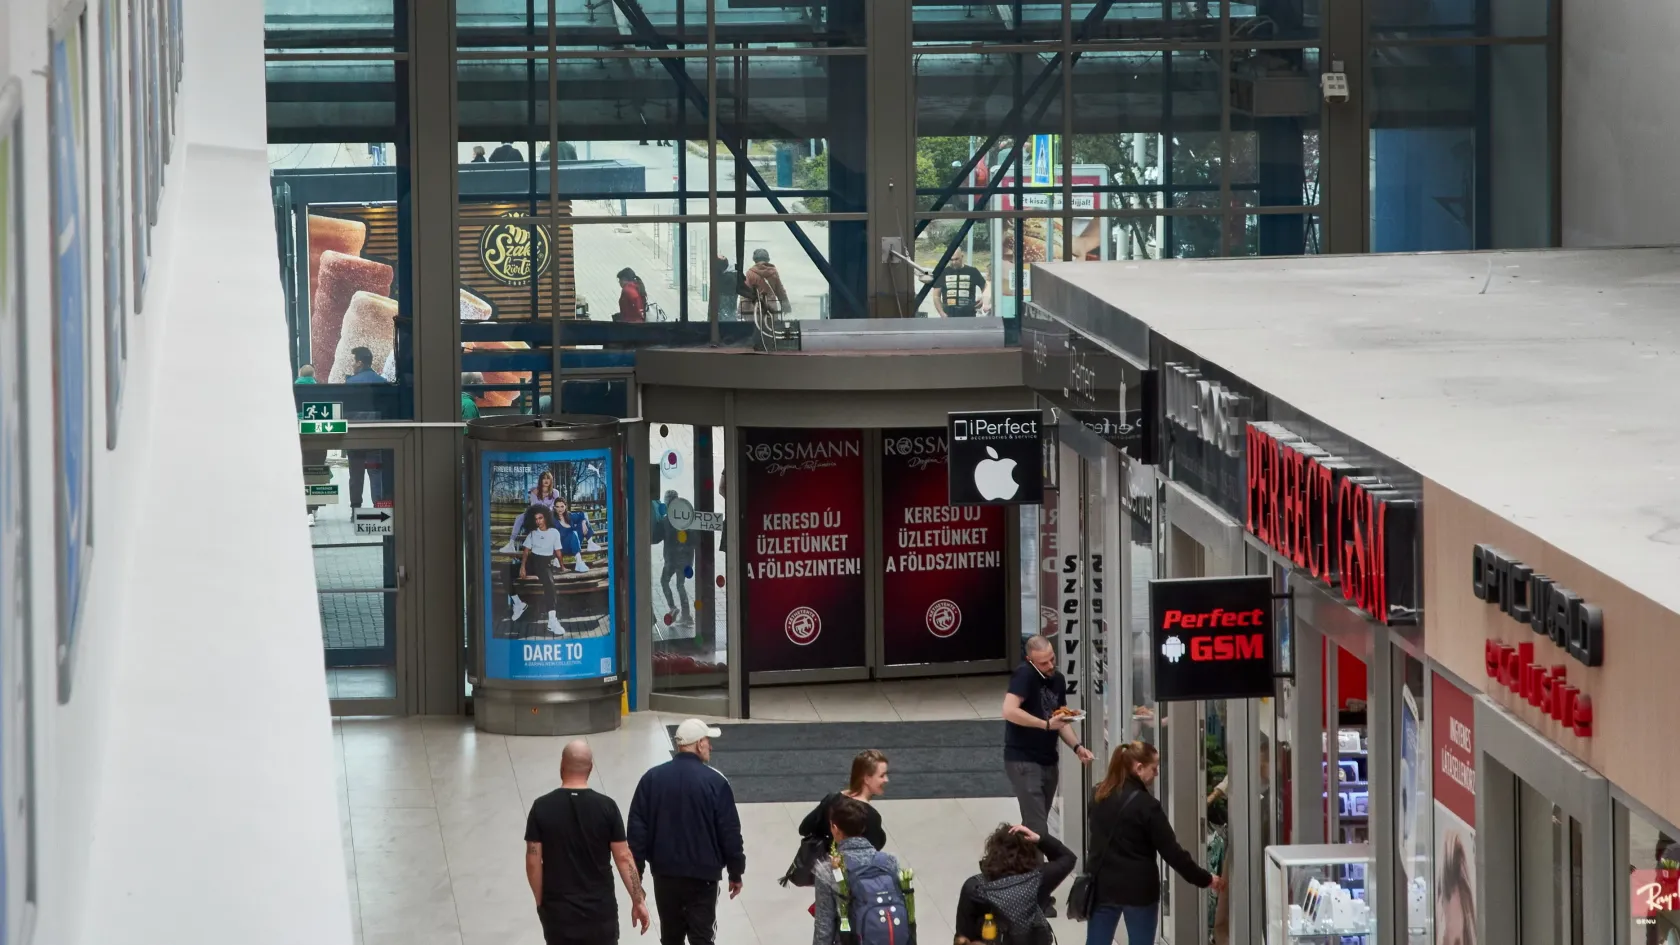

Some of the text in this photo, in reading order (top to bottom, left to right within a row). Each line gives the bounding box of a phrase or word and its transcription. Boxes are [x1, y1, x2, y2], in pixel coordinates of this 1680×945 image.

[970, 417, 1037, 435] iPerfect
[746, 440, 860, 462] ROSSMANN
[884, 436, 948, 456] ROSSM
[673, 508, 722, 522] LURDY
[904, 505, 961, 525] KERESD
[1246, 423, 1333, 588] PERFECT
[357, 523, 392, 535] Kijárat
[763, 506, 842, 531] KERESD ÚJ
[756, 534, 849, 556] ÜZLETÜNKET
[898, 525, 988, 549] ÜZLETÜNKET
[885, 550, 1001, 574] A FÖLDSZINTEN!
[1338, 475, 1388, 625] GSM
[747, 556, 861, 580] A FÖLDSZINTEN!
[1063, 555, 1079, 695] Szerviz
[1163, 608, 1264, 629] Perfect
[523, 643, 583, 662] DARE TO
[1190, 634, 1264, 661] GSM
[1441, 743, 1476, 795] LÁTÁSELLENŐRZ
[1636, 878, 1680, 911] Ray-
